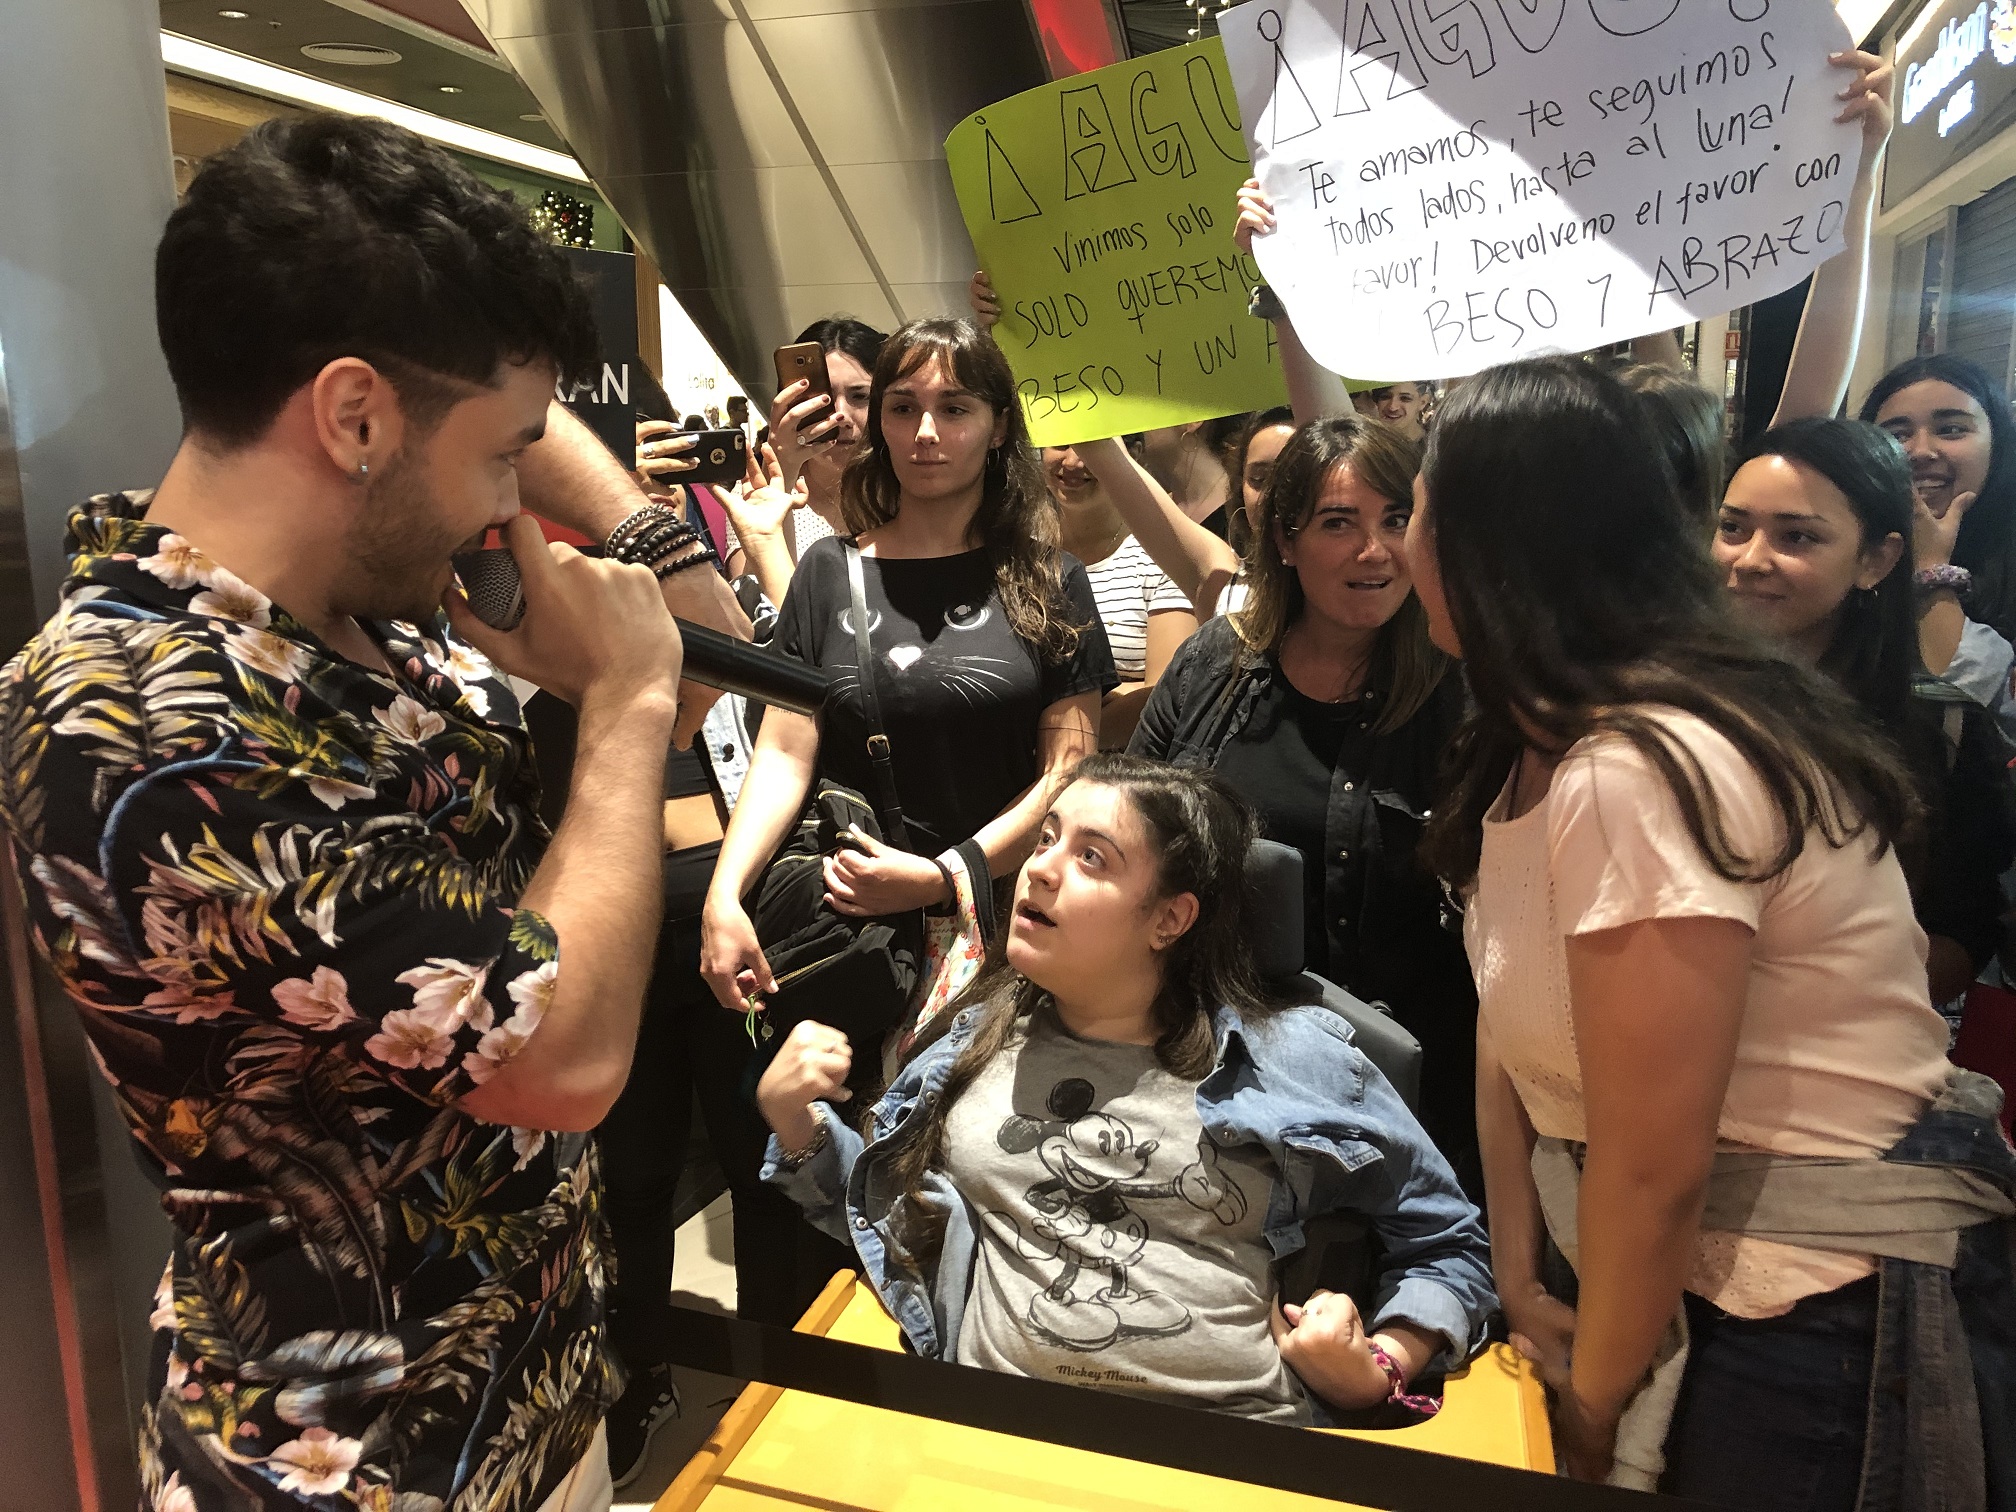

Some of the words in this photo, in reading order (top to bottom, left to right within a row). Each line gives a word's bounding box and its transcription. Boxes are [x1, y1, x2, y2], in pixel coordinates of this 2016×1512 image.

[1299, 161, 1337, 209] Te
[1518, 99, 1564, 138] te
[1588, 31, 1777, 125] seguimos
[1324, 207, 1394, 256] todos
[1510, 151, 1595, 205] hasta
[1626, 123, 1666, 158] al
[1470, 213, 1615, 274] Devolveno
[1636, 190, 1662, 225] el
[1676, 163, 1769, 225] favor
[1795, 153, 1840, 187] con
[1015, 292, 1088, 349] SOLO
[1424, 288, 1557, 355] BESO
[1648, 201, 1843, 316] ABRAZO
[1016, 365, 1124, 423] BESO
[1146, 349, 1162, 395] Y
[1194, 324, 1237, 376] UN
[1055, 1365, 1102, 1381] Mickey
[1104, 1370, 1149, 1384] Mouse
